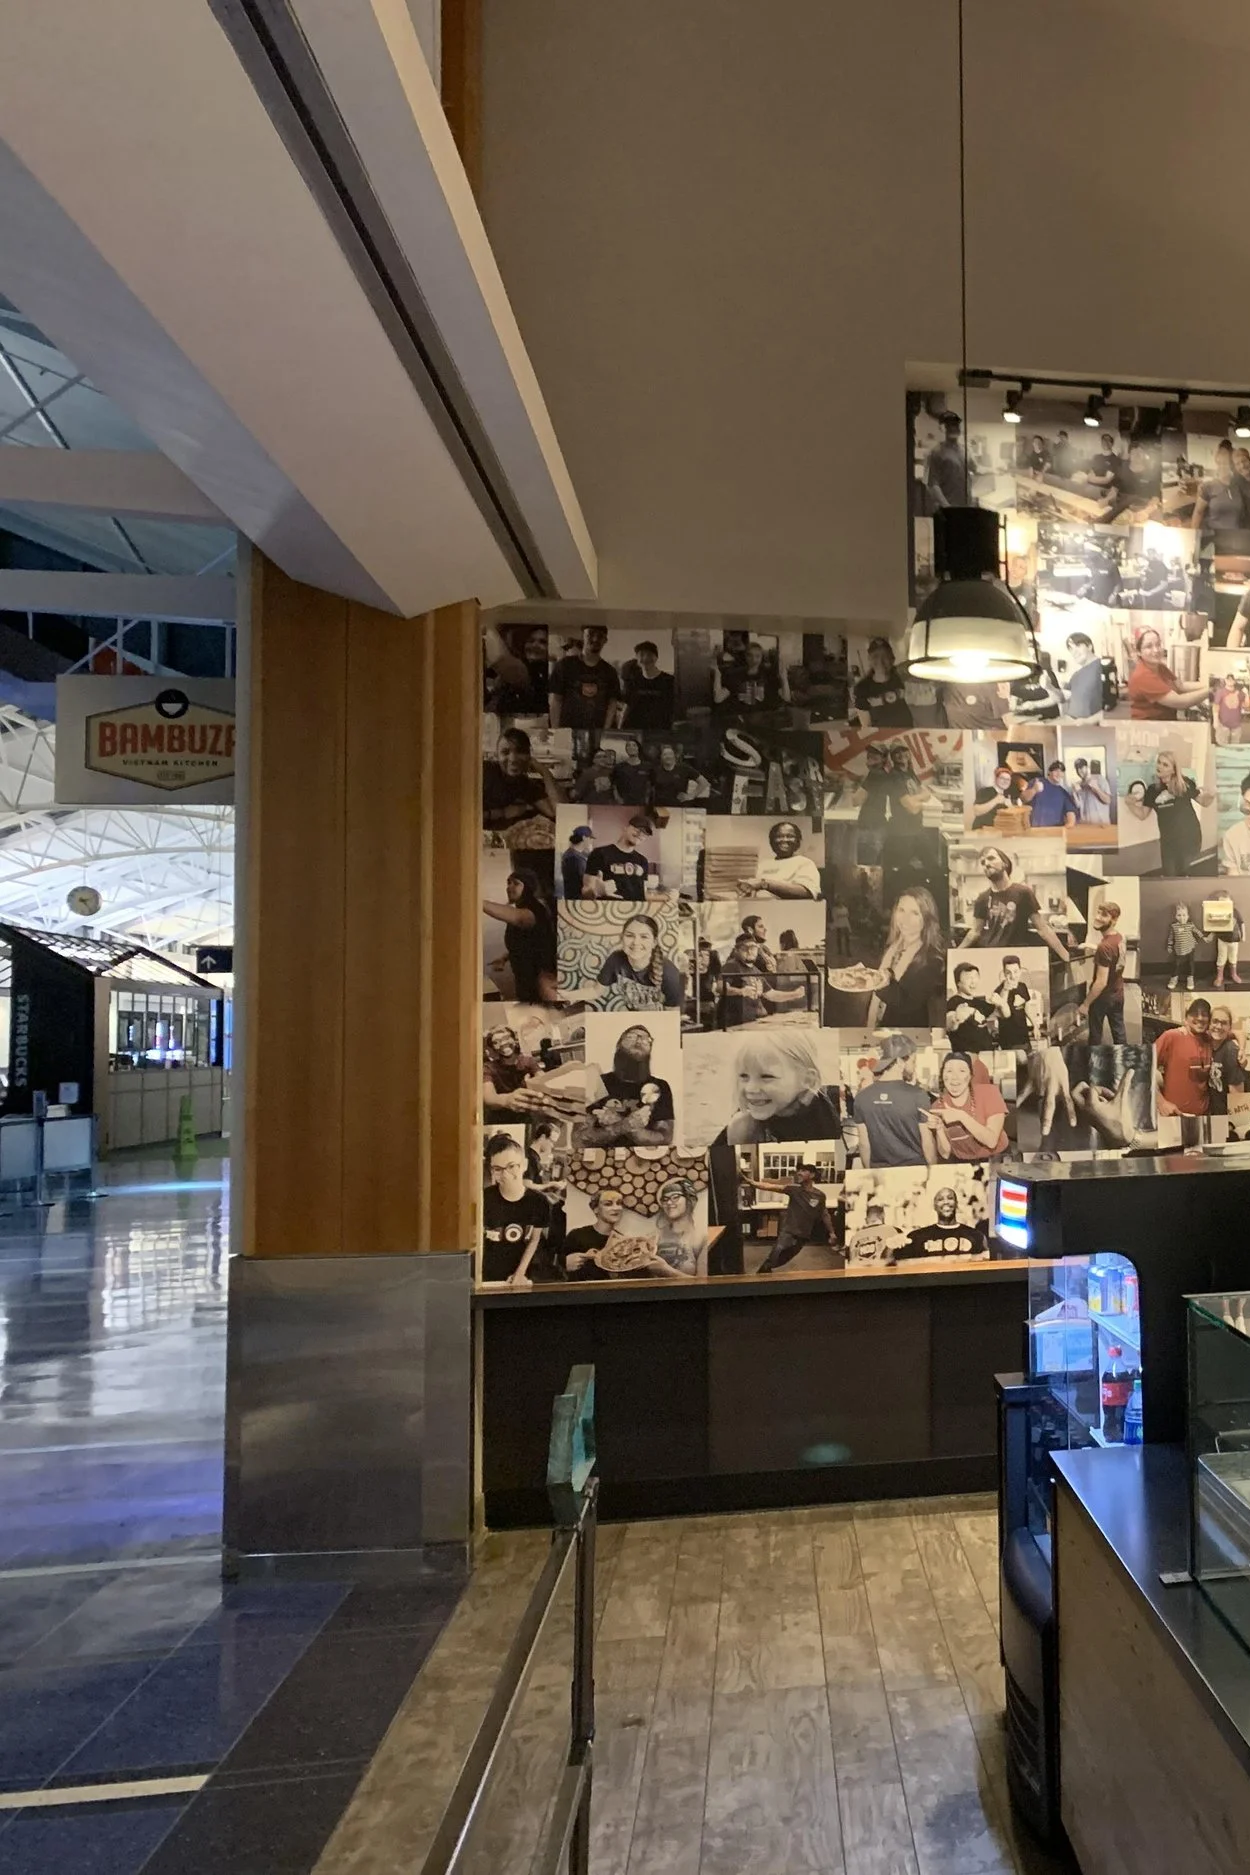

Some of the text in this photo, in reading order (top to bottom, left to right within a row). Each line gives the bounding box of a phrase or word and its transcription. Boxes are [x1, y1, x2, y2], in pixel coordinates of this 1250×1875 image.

[122, 759, 218, 767] VIETNAM KITCHEN
[15, 994, 30, 1087] STARBUCKS
